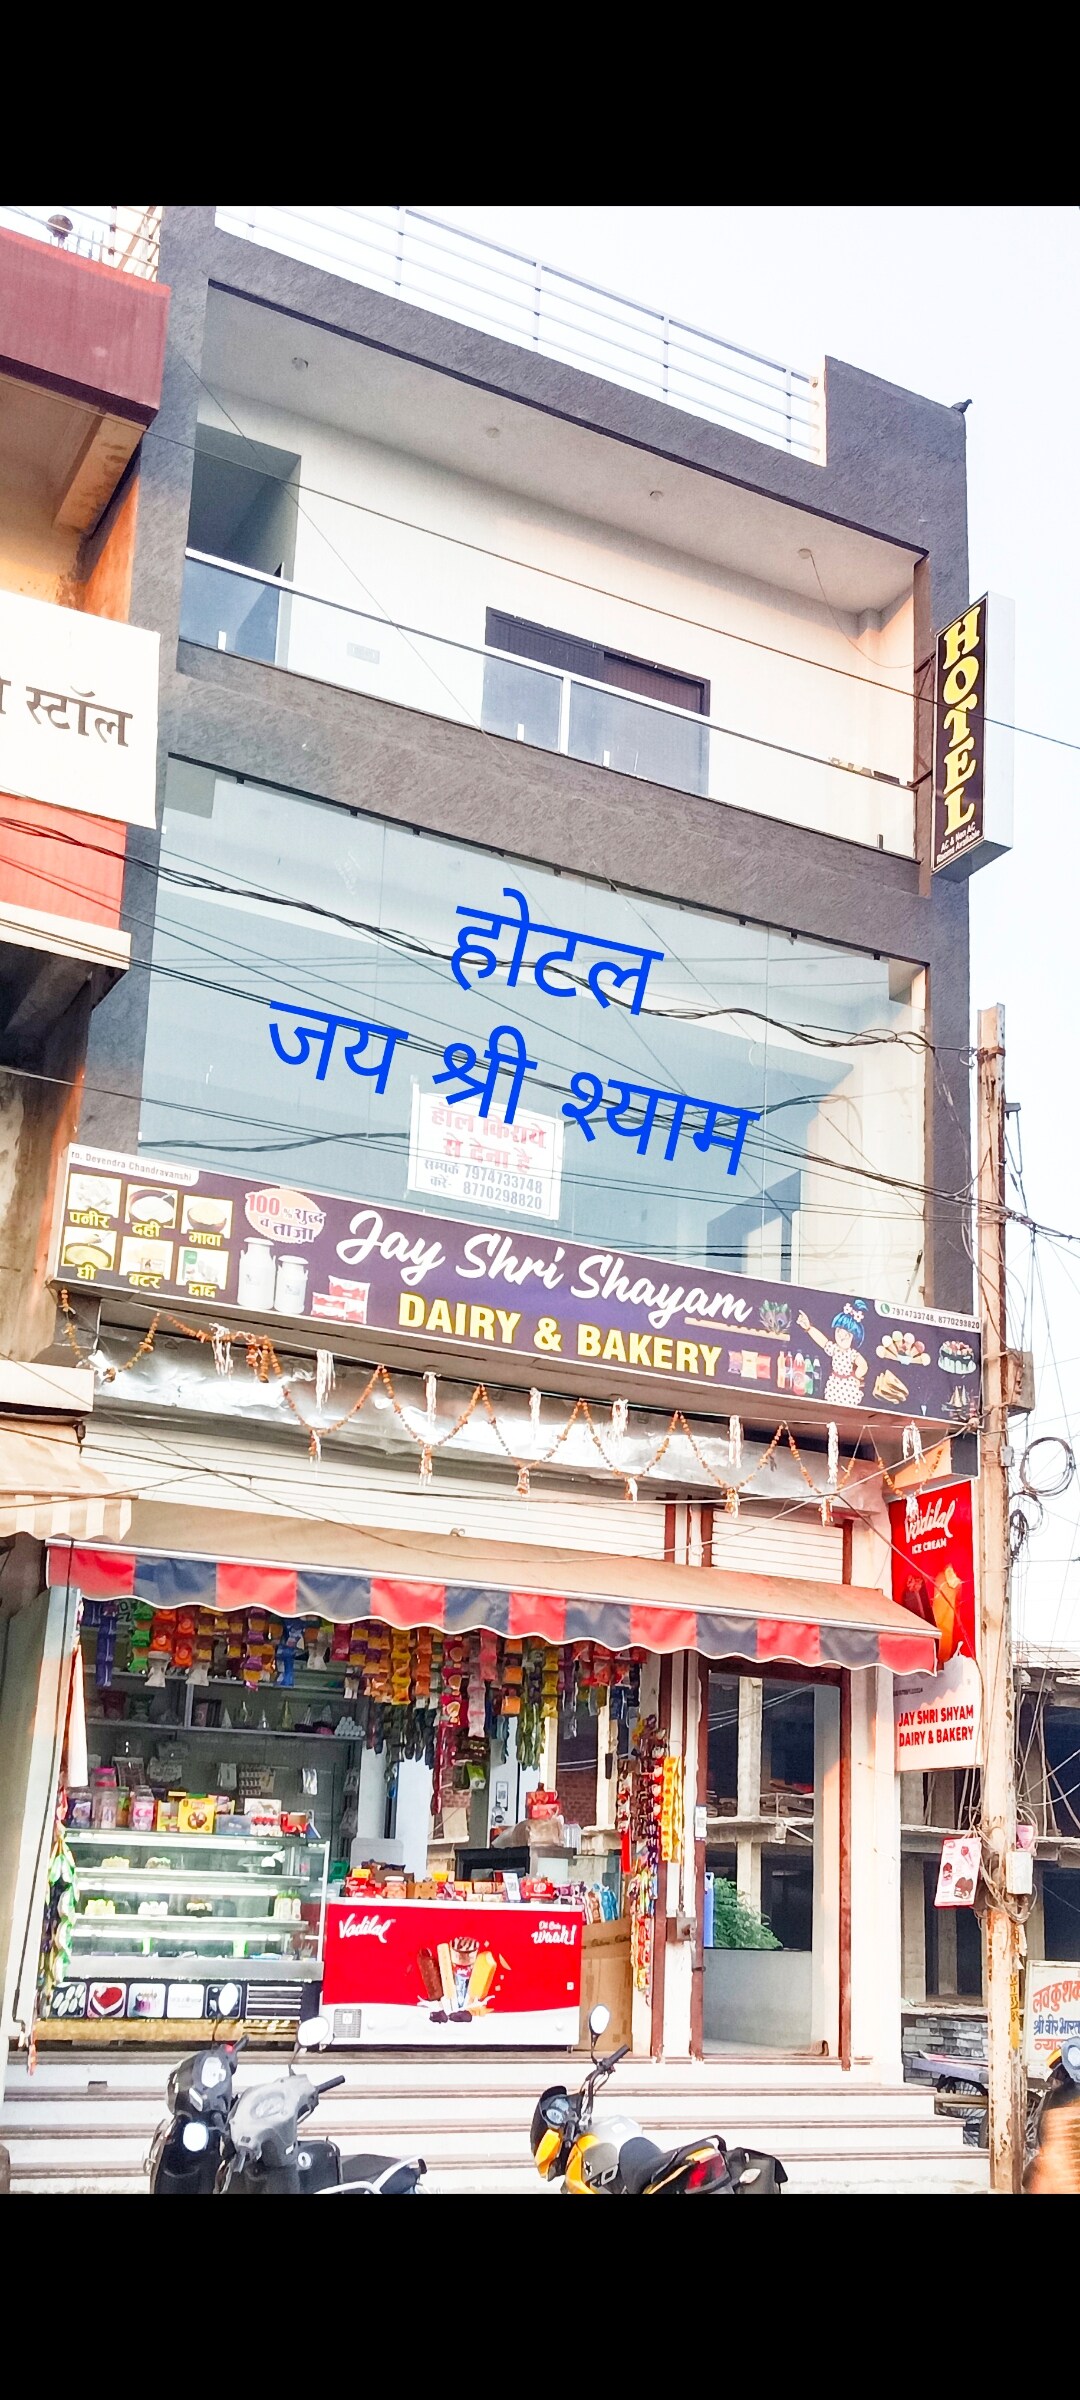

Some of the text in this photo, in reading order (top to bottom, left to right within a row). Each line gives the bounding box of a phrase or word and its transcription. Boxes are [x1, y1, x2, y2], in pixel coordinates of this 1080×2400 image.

[26, 685, 133, 747] स्टॉल
[943, 606, 981, 836] HOTEL
[86, 1153, 126, 1169] Devendra
[443, 1132, 464, 1158] से
[469, 1138, 511, 1169] देना
[464, 1164, 543, 1194] 7974733748
[463, 1181, 542, 1210] 8770298820
[69, 1209, 111, 1229] पनीर
[131, 1220, 161, 1238] दही
[188, 1230, 222, 1247] मावा
[76, 1263, 96, 1281] घी
[128, 1272, 162, 1289] बटर
[336, 1209, 753, 1330] Jay Shri Shayam
[398, 1291, 723, 1378] DAIRY & BAKERY
[898, 1704, 974, 1727] JAY SHRI SHYAM
[898, 1725, 974, 1748] DAIRY & BAKERY
[338, 1912, 392, 1944] Vadilal
